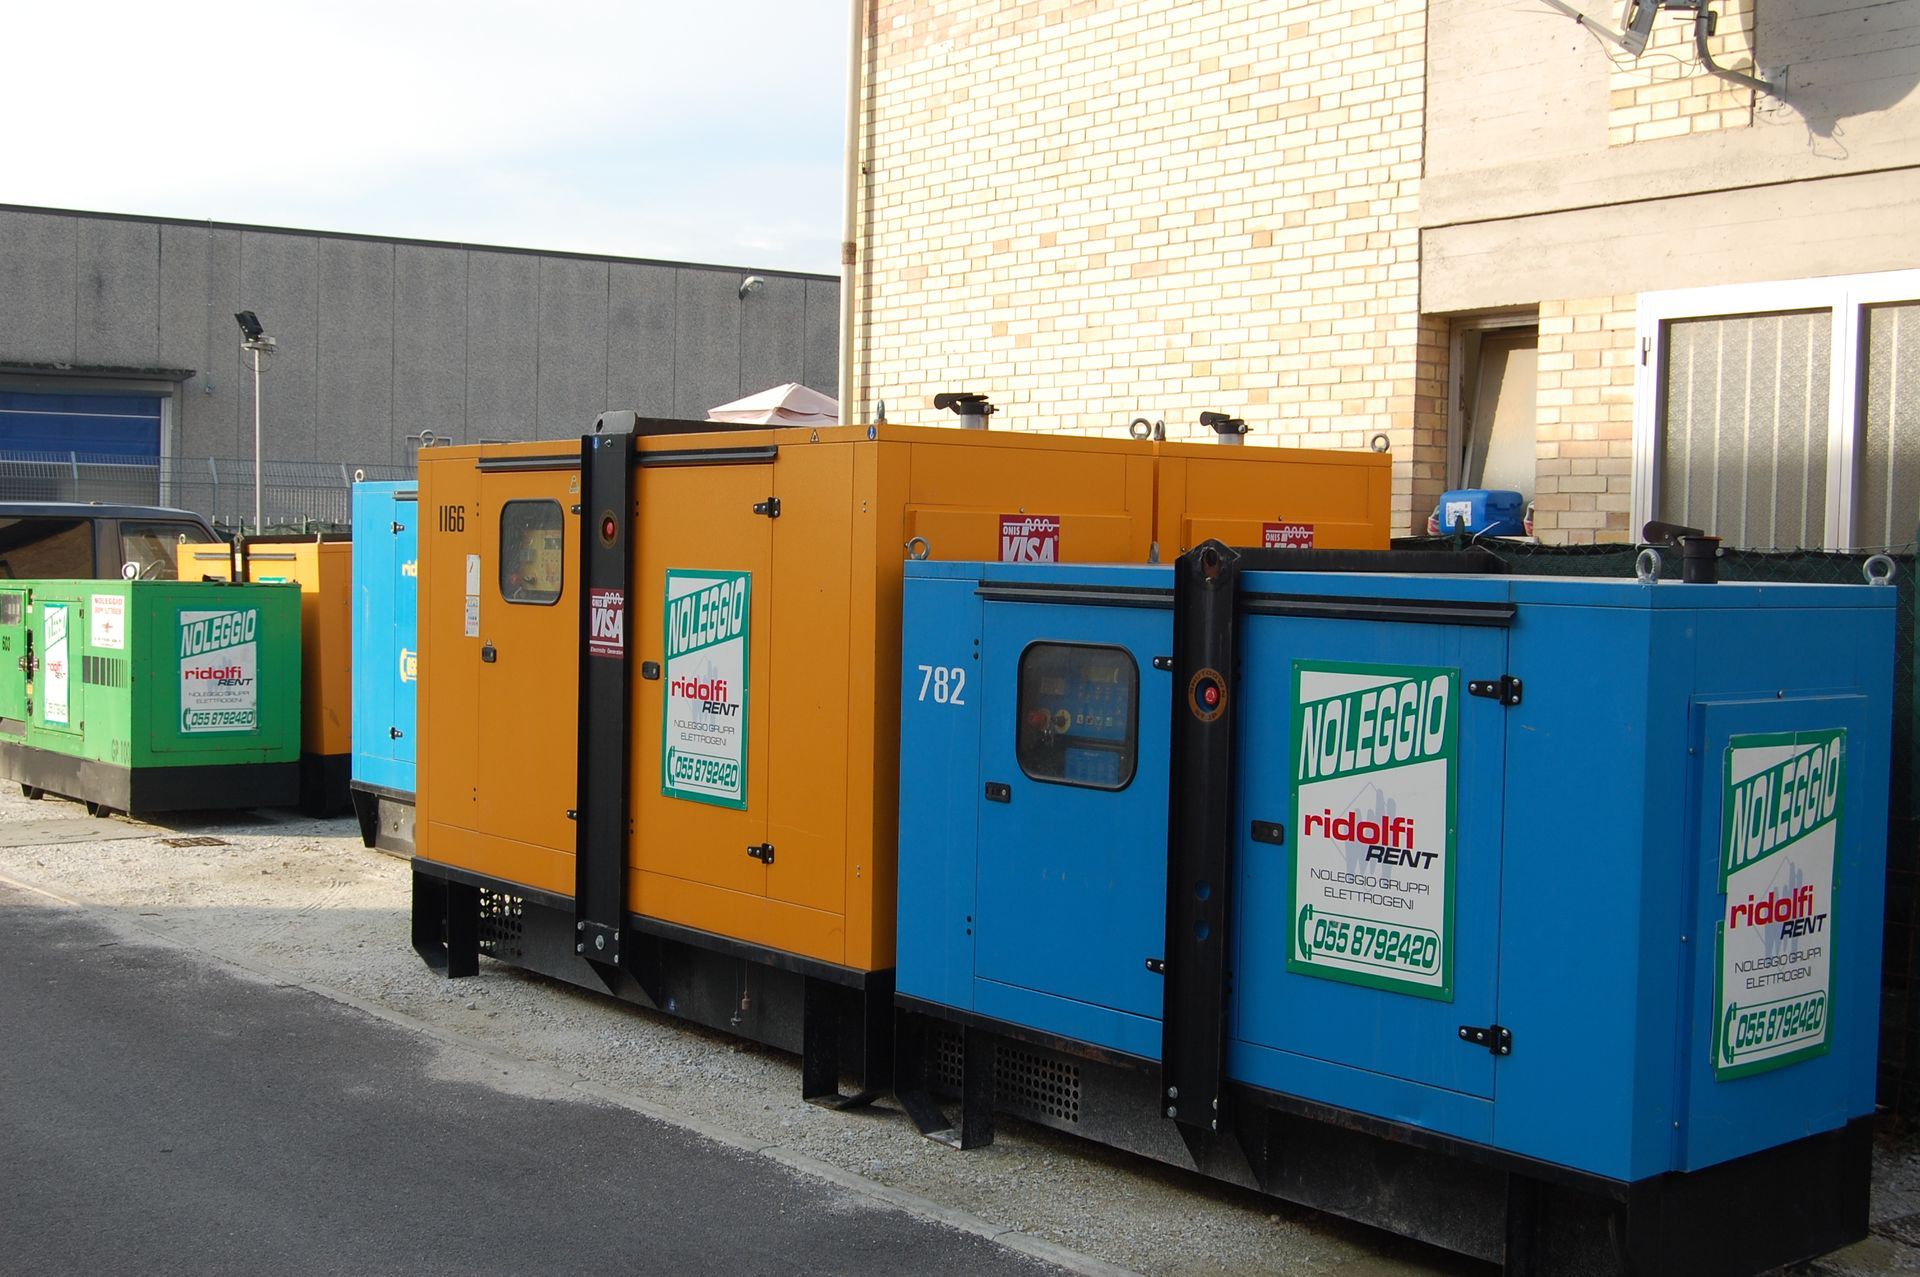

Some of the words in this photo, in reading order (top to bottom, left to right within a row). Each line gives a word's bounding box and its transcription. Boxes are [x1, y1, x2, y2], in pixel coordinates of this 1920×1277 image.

[439, 505, 465, 532] 1166
[1003, 526, 1020, 535] ONIS
[1003, 537, 1055, 562] VISA
[592, 608, 624, 638] VISA
[668, 576, 746, 656] NOLEGGIO
[181, 609, 257, 657] NOLEGGIO
[185, 666, 242, 680] ridolfi
[218, 678, 253, 687] RENT
[918, 664, 966, 706] 782
[671, 676, 727, 703] ridolfi
[191, 712, 210, 726] 055
[211, 711, 254, 725] 8792420
[702, 701, 740, 717] RENT
[674, 719, 708, 732] NOLEGGIO
[708, 723, 735, 735] GRUPPI
[680, 732, 727, 746] ELETTROGENI
[1298, 675, 1449, 780] NOLEGGIO
[675, 755, 695, 780] 055
[694, 759, 738, 788] 8792420
[1727, 737, 1841, 870] NOLEGGIO
[1304, 809, 1415, 849] ridolfi
[1365, 845, 1438, 870] RENT
[1310, 867, 1377, 888] NOLEGGIO
[1378, 878, 1430, 896] GRUPPI
[1324, 886, 1414, 910] ELETTROGENI
[1729, 885, 1814, 929] ridolfi
[1780, 913, 1827, 940] RENT
[1313, 919, 1350, 953] 055
[1351, 925, 1437, 969] 8792420
[1735, 954, 1787, 974] NOLEGGIO
[1788, 947, 1822, 963] GRUPPI
[1746, 966, 1812, 990] ELETTROGENI
[1735, 1012, 1767, 1049] 055
[1766, 996, 1825, 1043] 8792420
